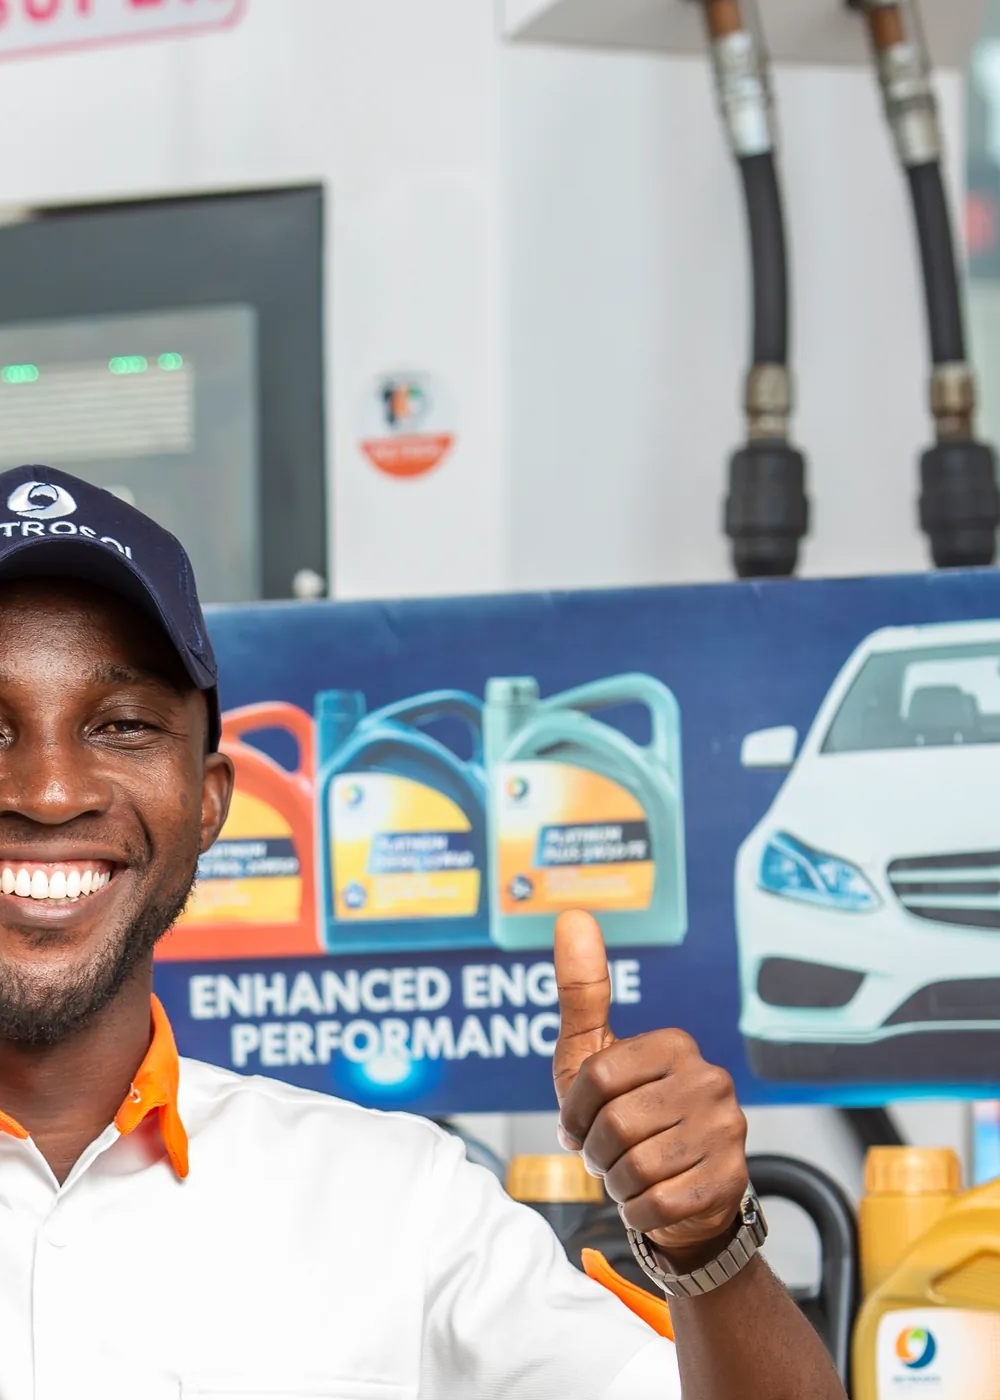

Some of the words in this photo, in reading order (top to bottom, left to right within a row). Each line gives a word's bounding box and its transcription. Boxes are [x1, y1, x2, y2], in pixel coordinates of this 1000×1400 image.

[189, 967, 451, 1019] ENHANCED
[461, 959, 642, 1009] ENGE
[231, 1012, 561, 1067] PERFORMANC
